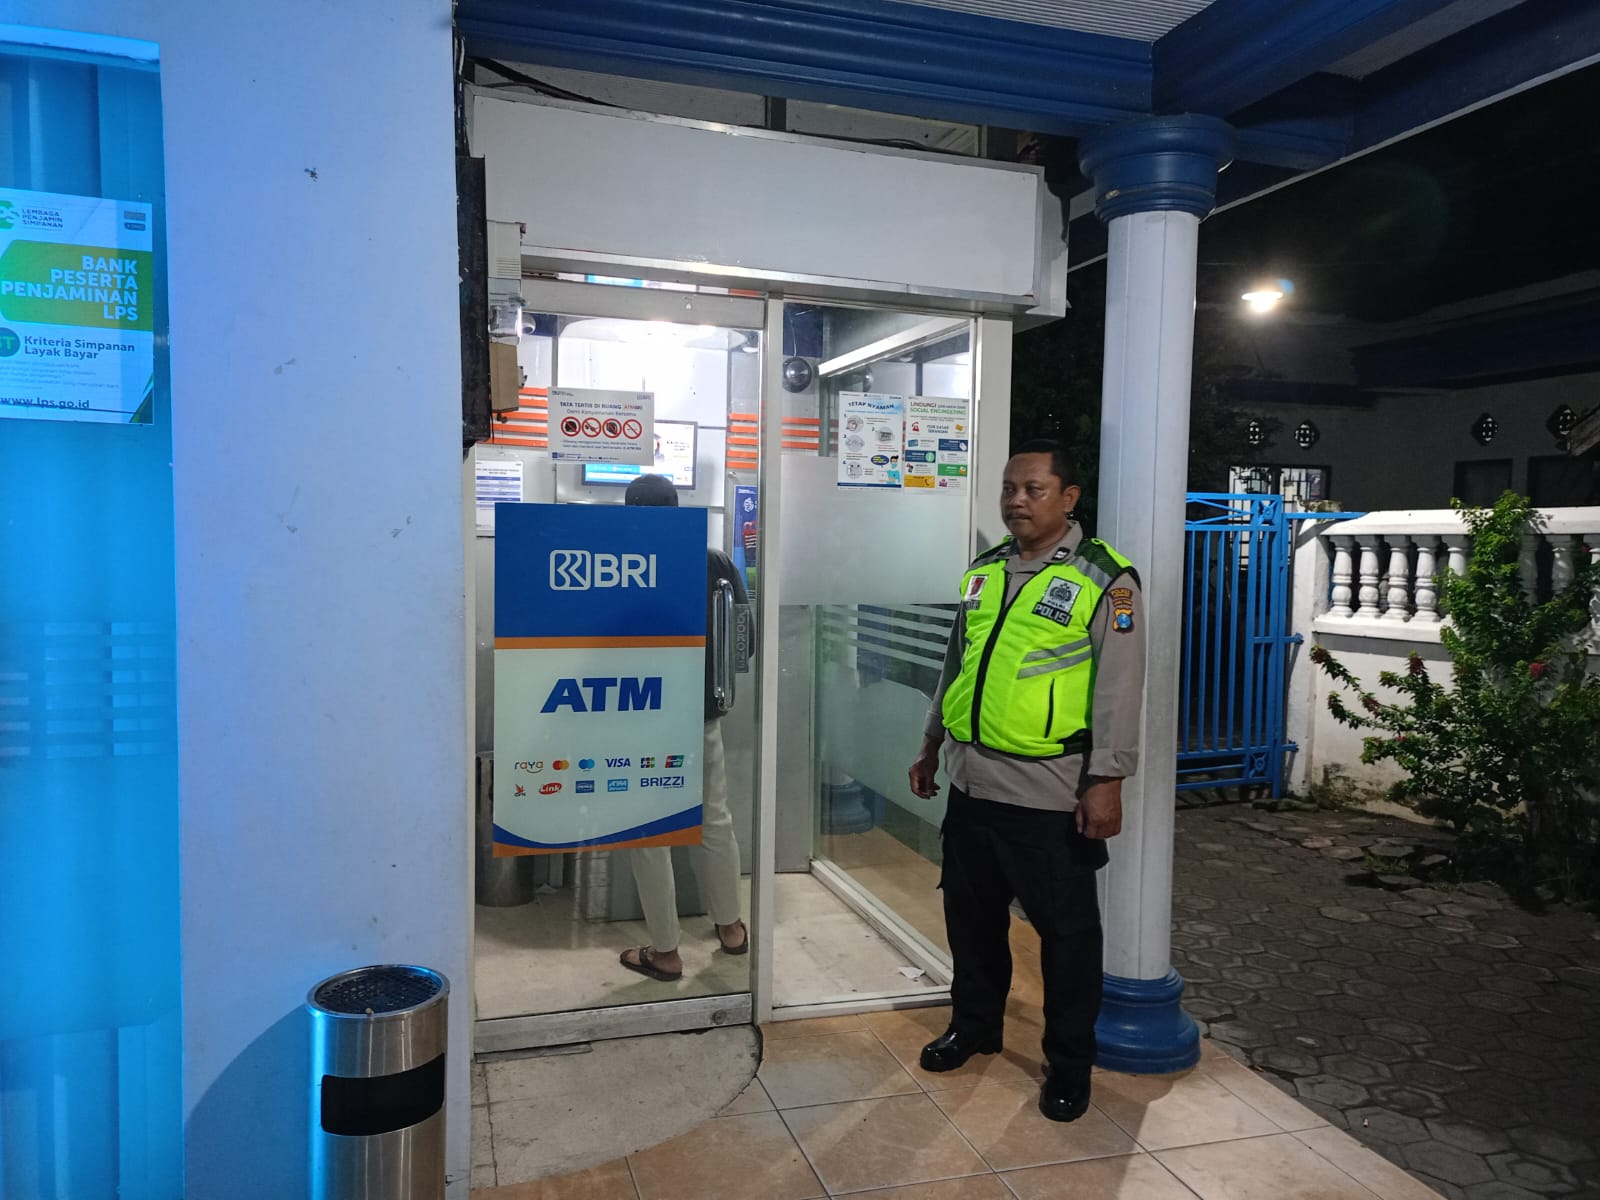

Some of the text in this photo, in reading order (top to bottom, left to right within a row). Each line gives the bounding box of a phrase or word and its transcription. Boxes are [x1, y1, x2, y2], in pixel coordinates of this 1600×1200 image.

[22, 208, 60, 217] LEMBAGA
[22, 213, 63, 223] PENJAMIN
[22, 219, 64, 228] SIMPANAN
[82, 255, 138, 273] BANK
[51, 268, 138, 290] PESERTA
[1, 280, 137, 305] PENJAMINAN
[103, 304, 138, 321] LPS
[24, 335, 135, 352] Kriteria Simpanan
[24, 346, 99, 360] Layak Bayar
[868, 402, 895, 410] NYAMAN
[594, 554, 657, 588] BRI
[1033, 603, 1071, 625] POLISI
[540, 677, 662, 713] ATM
[515, 760, 544, 772] raya
[605, 757, 631, 768] VISA
[540, 783, 561, 793] Link
[640, 776, 685, 788] BRIZZI
